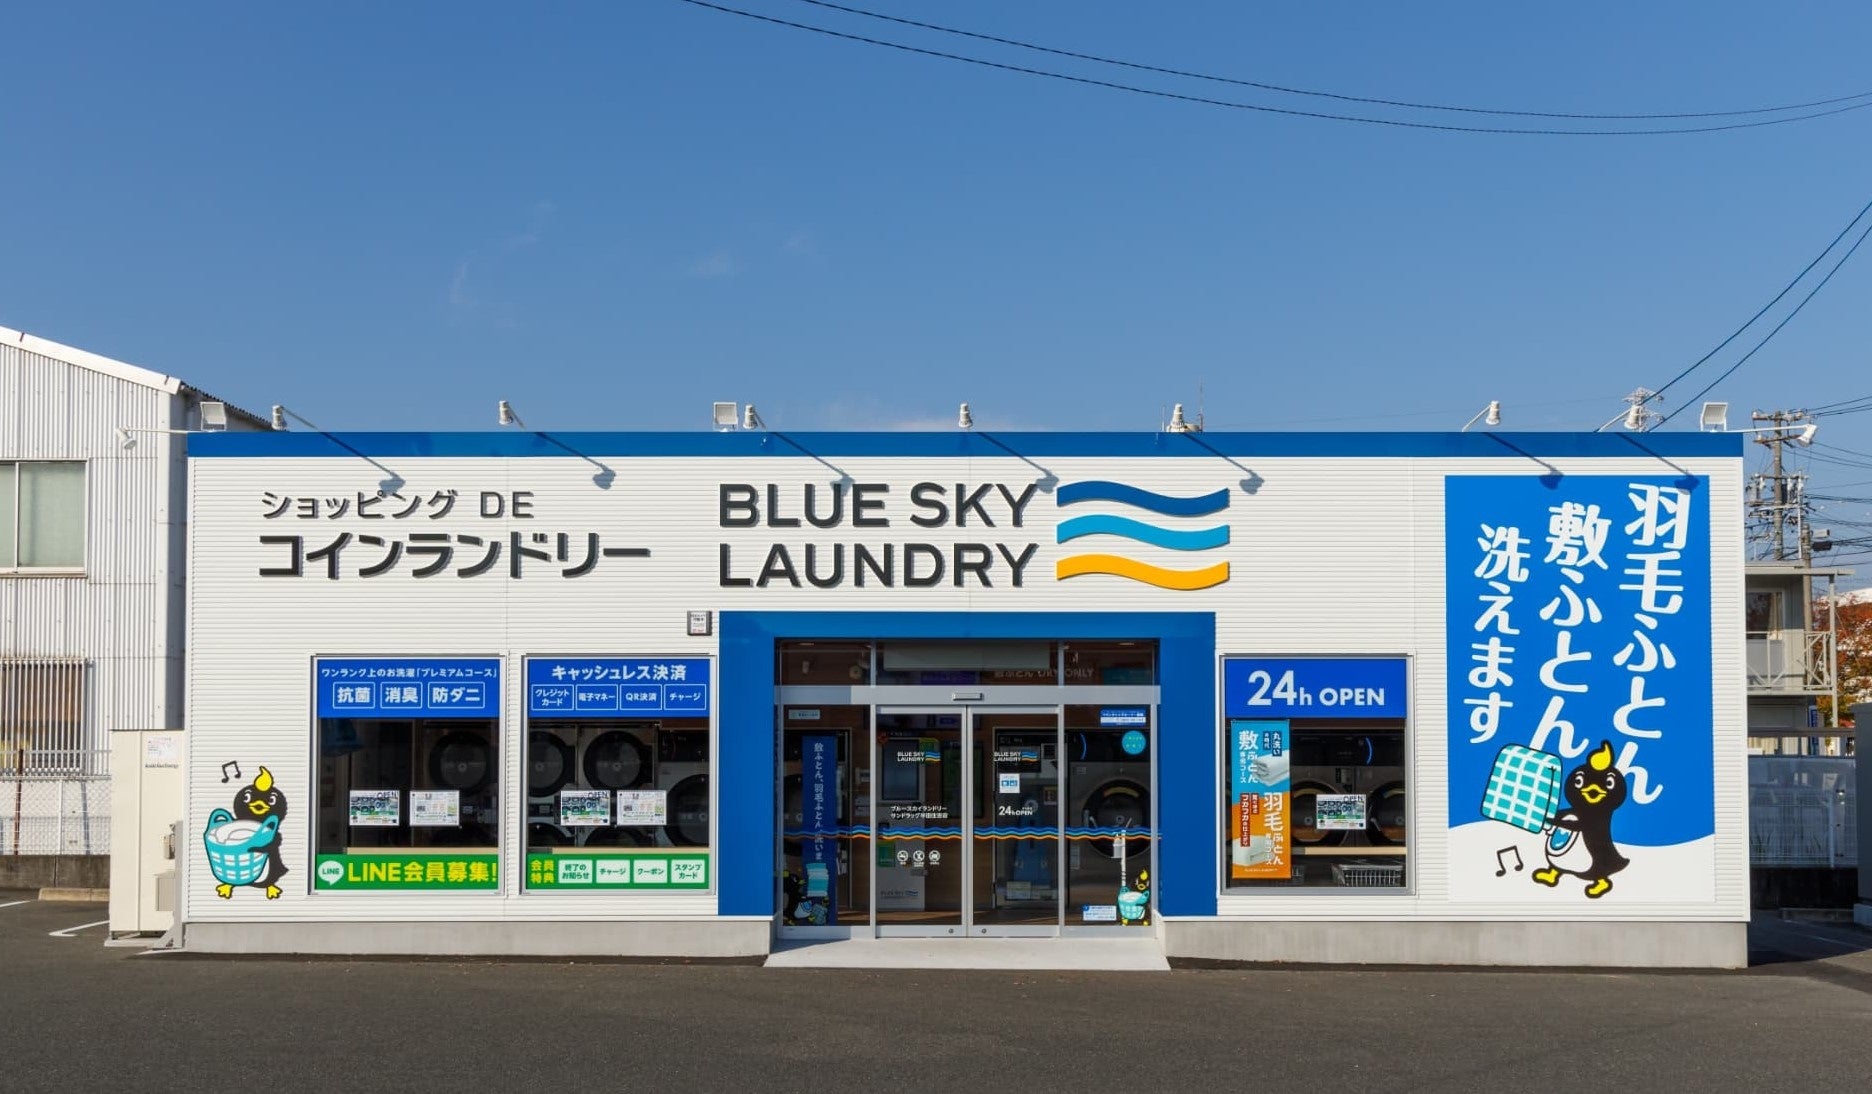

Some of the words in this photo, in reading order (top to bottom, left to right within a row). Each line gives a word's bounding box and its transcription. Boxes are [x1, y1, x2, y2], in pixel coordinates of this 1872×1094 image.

[262, 489, 458, 519] ショッピング
[480, 491, 534, 519] DE
[719, 483, 890, 529] BLUE
[909, 482, 1039, 529] SKY
[259, 532, 651, 580] コインランドリー
[719, 543, 1040, 589] LAUNDRY
[1463, 523, 1531, 744] 洗えます
[1529, 501, 1613, 759] 敷ふとん
[1612, 482, 1692, 806] 羽毛ふとん
[551, 664, 687, 681] キャッシュレス決済
[337, 686, 371, 704] 抗菌
[385, 686, 419, 704] 消臭
[432, 686, 481, 704] 防ダニ
[535, 689, 570, 698] クレジット
[625, 692, 657, 702] QR決済
[1246, 670, 1313, 707] 24h
[1318, 687, 1385, 707] OPEN
[541, 699, 563, 707] カード
[578, 693, 616, 702] 電子マネー
[669, 693, 702, 702] チャージ
[1263, 792, 1284, 866] 羽毛ふとん
[322, 868, 340, 876] LINE
[561, 872, 590, 880] お知らせ
[599, 868, 627, 876] チャージ
[637, 868, 665, 876] クーポン
[674, 863, 703, 872] スタンプ
[678, 872, 699, 880] カード
